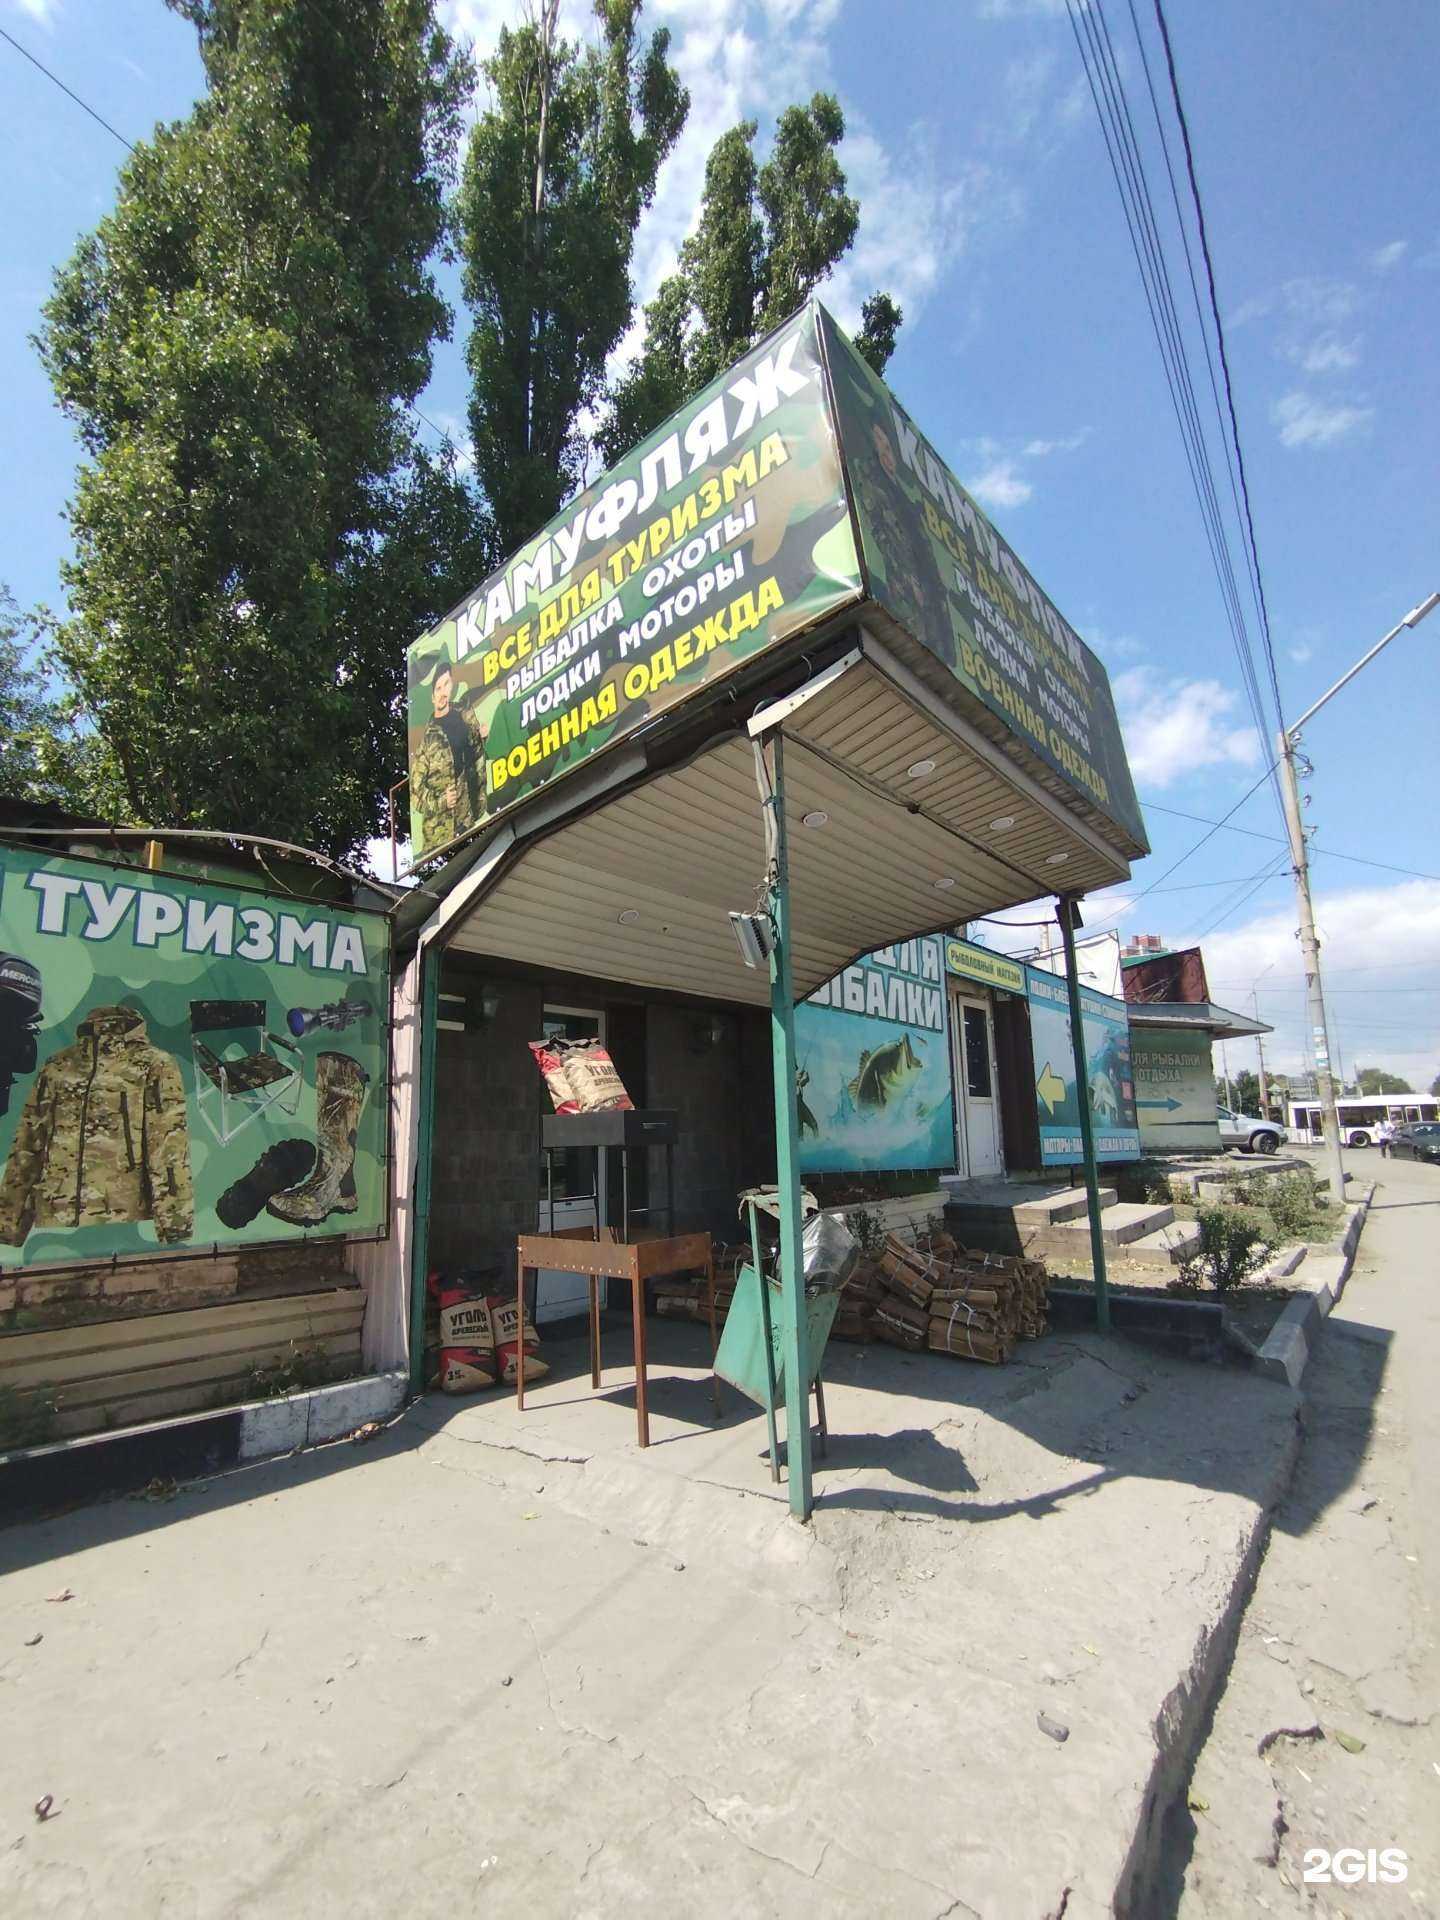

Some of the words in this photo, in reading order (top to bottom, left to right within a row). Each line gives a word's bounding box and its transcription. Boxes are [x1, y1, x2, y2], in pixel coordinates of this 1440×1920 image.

[454, 332, 812, 660] КАМУФЛЯЖ
[482, 634, 532, 686] ВСЕ
[538, 570, 602, 646] ДЛЯ
[608, 431, 791, 590] ТУРИЗМА
[890, 406, 1090, 683] КАМУФЛЯЖ
[923, 497, 971, 575] ВСЕ
[492, 683, 618, 792] ВОЕННАЯ
[624, 575, 785, 700] ОДЕЖДА
[506, 597, 624, 701] РЫБАЛКА
[642, 497, 757, 598] ОХОТЫ
[520, 656, 601, 729] ЛОДКИ
[618, 550, 745, 660] МОТОРЫ
[954, 567, 1037, 672] РЫБАЛКА
[1044, 667, 1090, 725] ОХОТЫ
[960, 638, 1048, 748] ВОЕННАЯ
[1048, 731, 1111, 805] ОДЕЖДА
[974, 618, 1031, 693] ЛОДКИ
[1038, 685, 1092, 756] МОТОРЫ
[28, 872, 368, 974] ТУРИЗМА
[450, 1308, 487, 1326] УГОЛЬ
